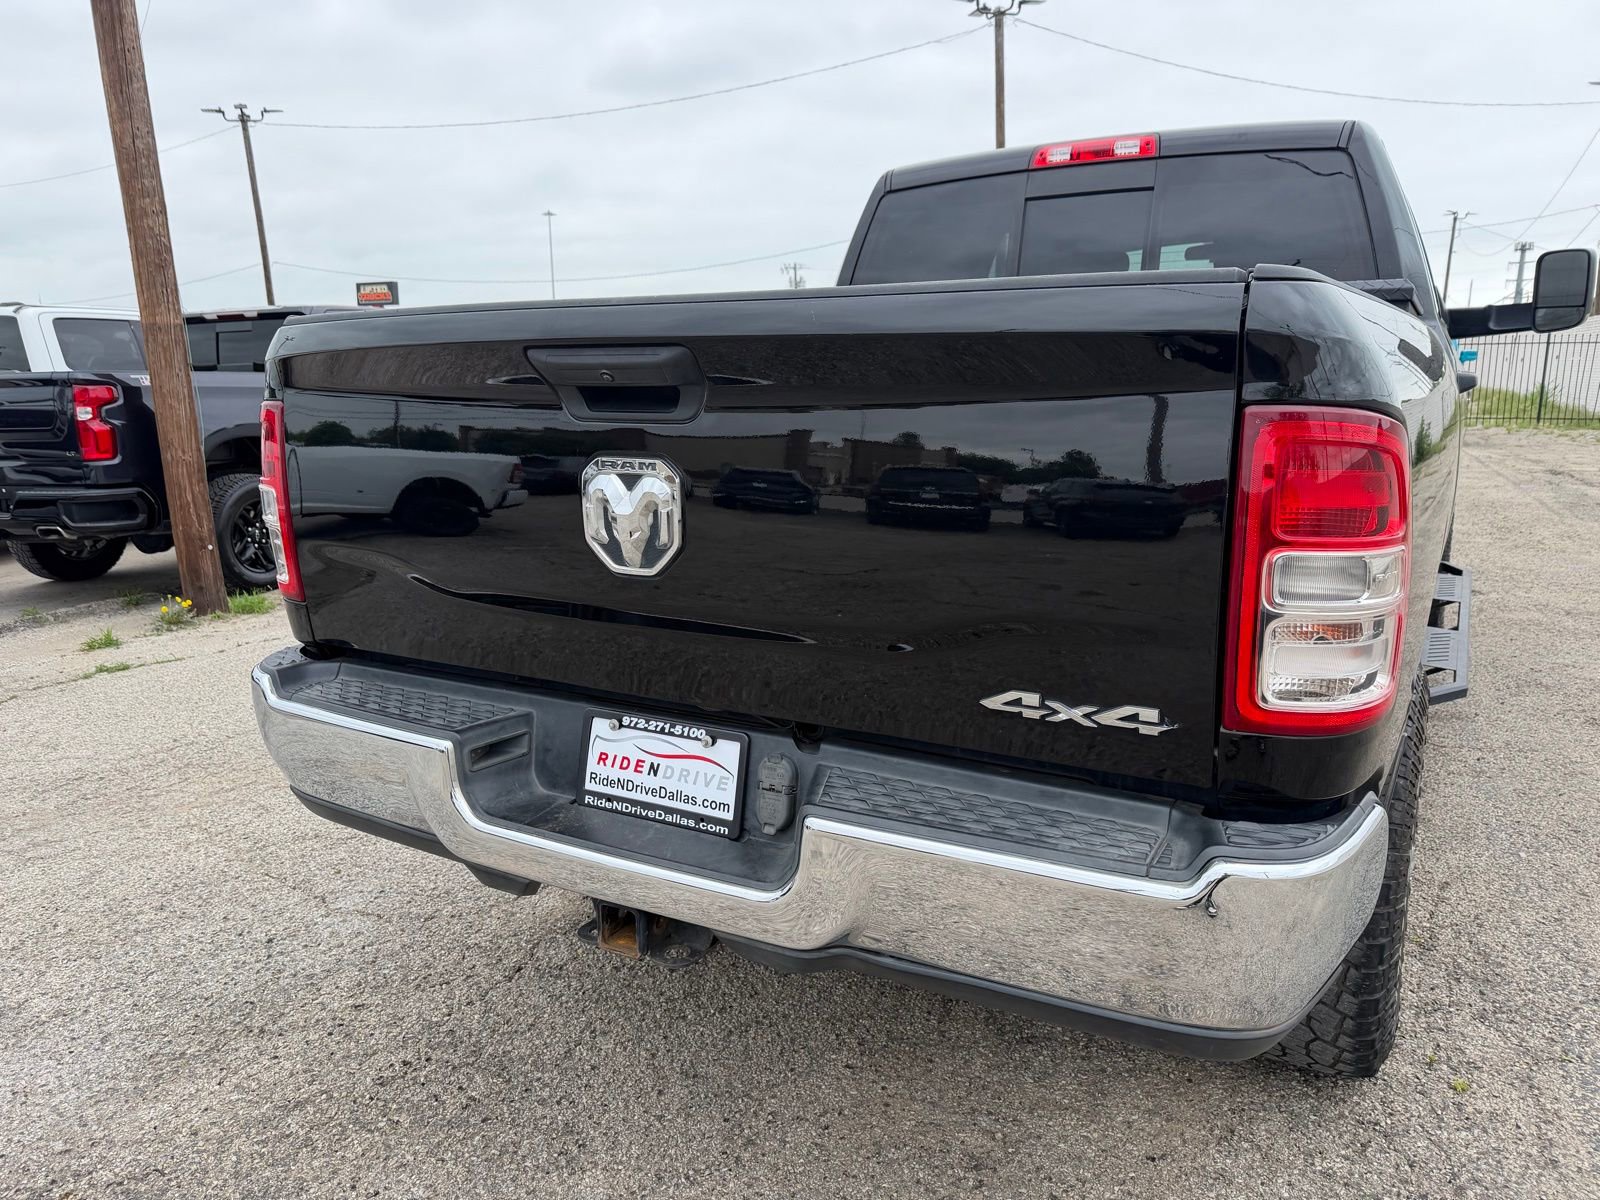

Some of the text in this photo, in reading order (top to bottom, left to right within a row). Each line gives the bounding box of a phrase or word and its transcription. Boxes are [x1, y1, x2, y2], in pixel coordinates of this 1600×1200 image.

[600, 460, 657, 471] RAM
[621, 716, 707, 739] 972-271-5100
[589, 772, 730, 813] RideNDriveDallas.com
[584, 795, 729, 835] RideNDriveDallas.com
